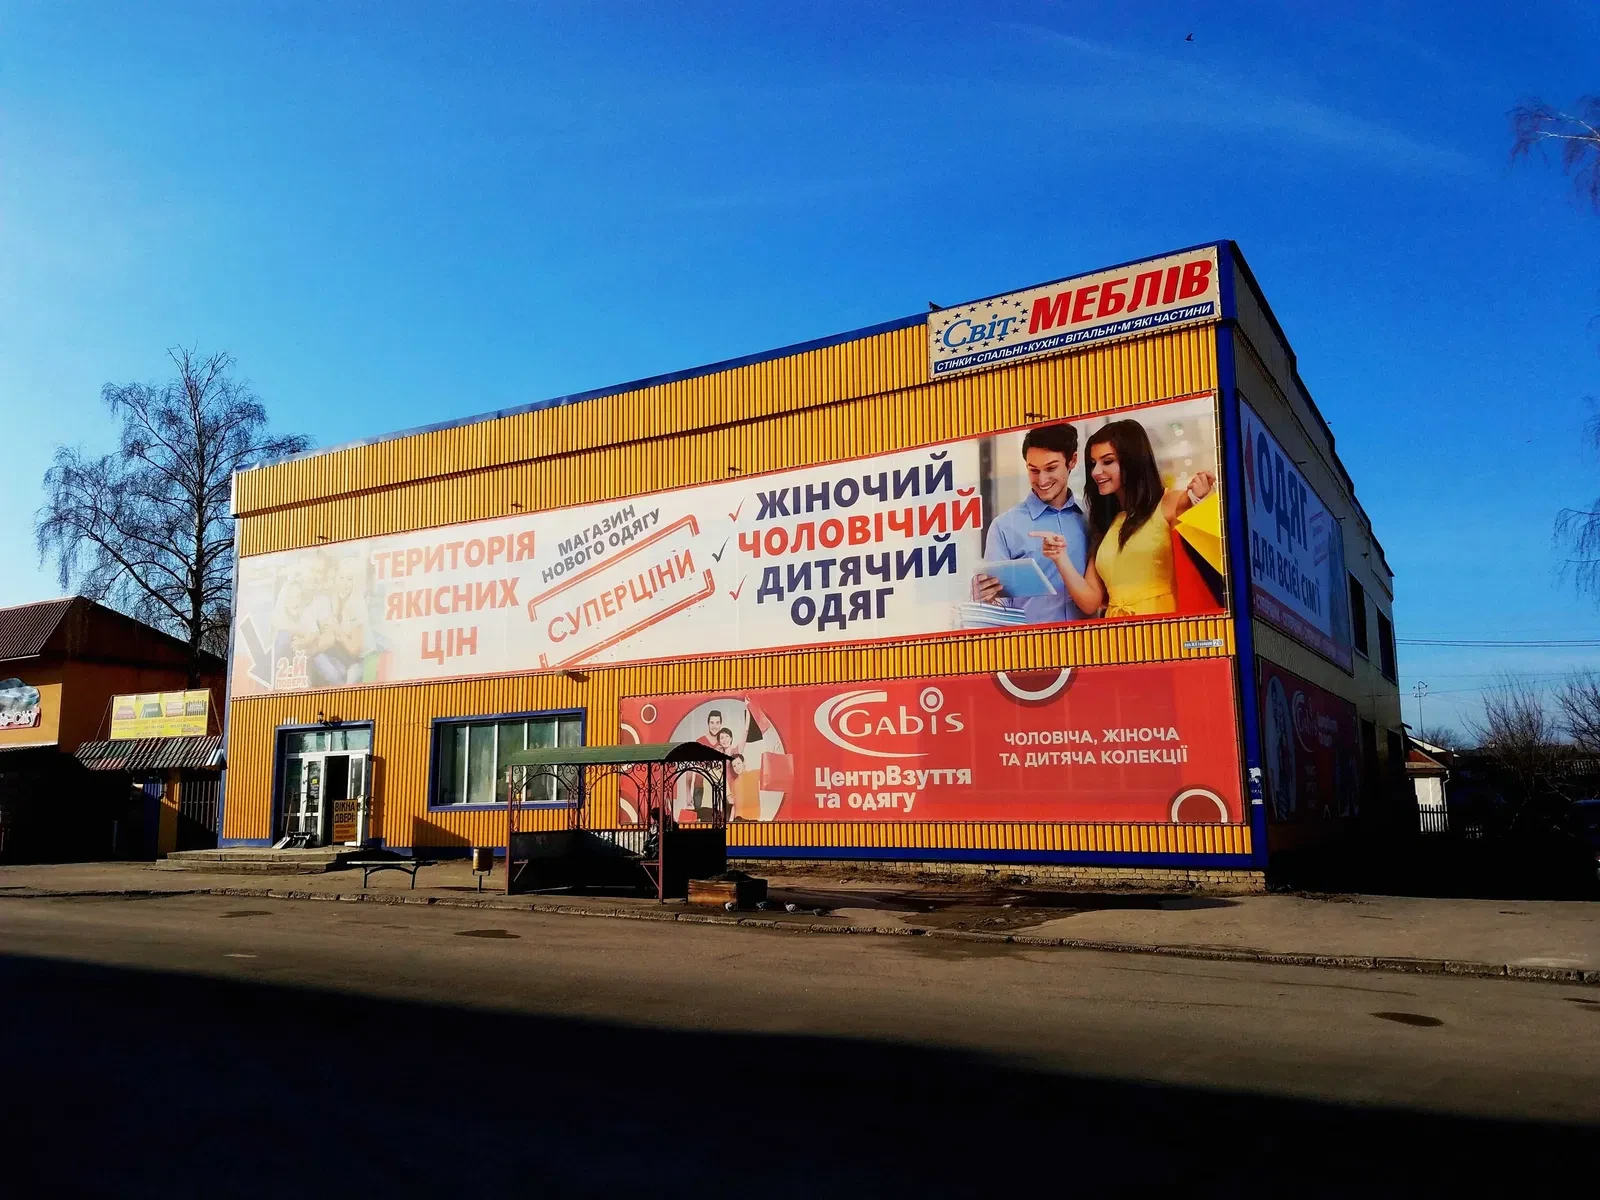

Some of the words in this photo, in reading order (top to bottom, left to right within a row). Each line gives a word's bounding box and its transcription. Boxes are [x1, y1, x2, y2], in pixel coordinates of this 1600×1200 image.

[942, 313, 1017, 348] Світ
[1028, 259, 1212, 334] МЕБЛІВ
[936, 356, 973, 371] СТІНКИ
[976, 345, 1023, 363] СПАЛЬНІ
[1027, 336, 1060, 352] КУХНІ
[1065, 325, 1117, 343] ВІТАЛЬНІ
[1120, 316, 1153, 332] М'ЯКІ
[1154, 304, 1211, 323] ЧАСТИНИ
[755, 450, 954, 521] ЖІНОЧИЙ
[1257, 431, 1308, 554] ОДЯГ
[541, 540, 605, 584] НОВОГО
[608, 507, 661, 548] ОДЯГУ
[557, 504, 636, 557] МАГАЗИН
[738, 486, 982, 559] ЧОЛОВІЧИЙ
[373, 529, 536, 580] ТЕРИТОРІЯ
[757, 532, 958, 605] ДИТЯЧИЙ
[1252, 529, 1276, 582] ДЛЯ
[384, 576, 521, 621] ЯКІСНИХ
[547, 548, 697, 643] СУПЕРЦІНИ
[790, 587, 895, 632] ОДЯГ
[421, 626, 478, 665] ЦІН
[999, 752, 1021, 767] ТА
[1025, 751, 1097, 768] ДИТЯЧА
[1101, 745, 1188, 765] КОЛЕКЦІЇ
[1004, 730, 1098, 746] ЧОЛОВІЧА,
[1102, 727, 1180, 743] ЖІНОЧА
[815, 765, 972, 790] ЦентрВзуття
[815, 793, 841, 809] та
[848, 792, 916, 813] одягу
[335, 801, 355, 812] ВІКНА
